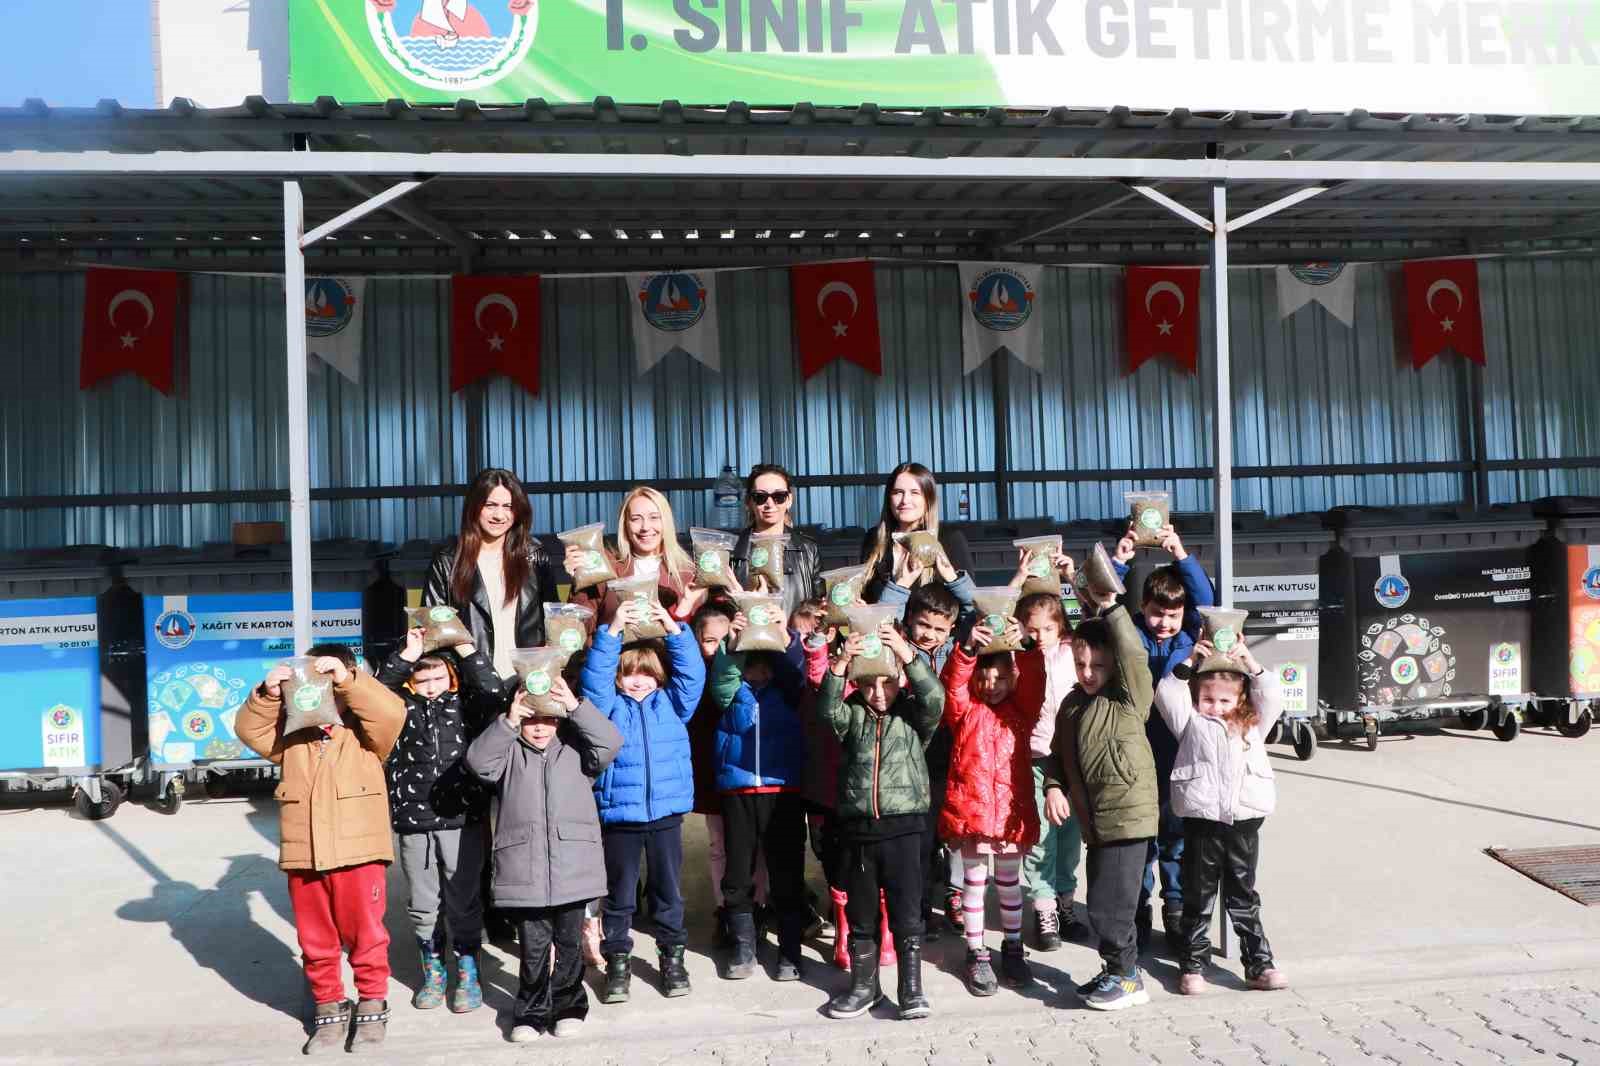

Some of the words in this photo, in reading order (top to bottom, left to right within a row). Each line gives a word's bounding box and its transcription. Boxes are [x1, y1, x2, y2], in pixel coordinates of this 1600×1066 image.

[673, 0, 864, 54] SINIF
[893, 0, 1066, 55] ATIK
[1253, 584, 1275, 592] ATIK
[1278, 583, 1316, 591] KUTUSU
[201, 620, 232, 630] KAĞIT
[235, 621, 249, 630] VE
[251, 620, 293, 629] KARTON
[320, 618, 361, 628] KUTUSU
[29, 626, 50, 635] ATIK
[54, 624, 96, 633] KUTUSU
[58, 641, 69, 649] 20
[1492, 667, 1518, 678] SIFIR
[47, 733, 80, 745] SIFIR
